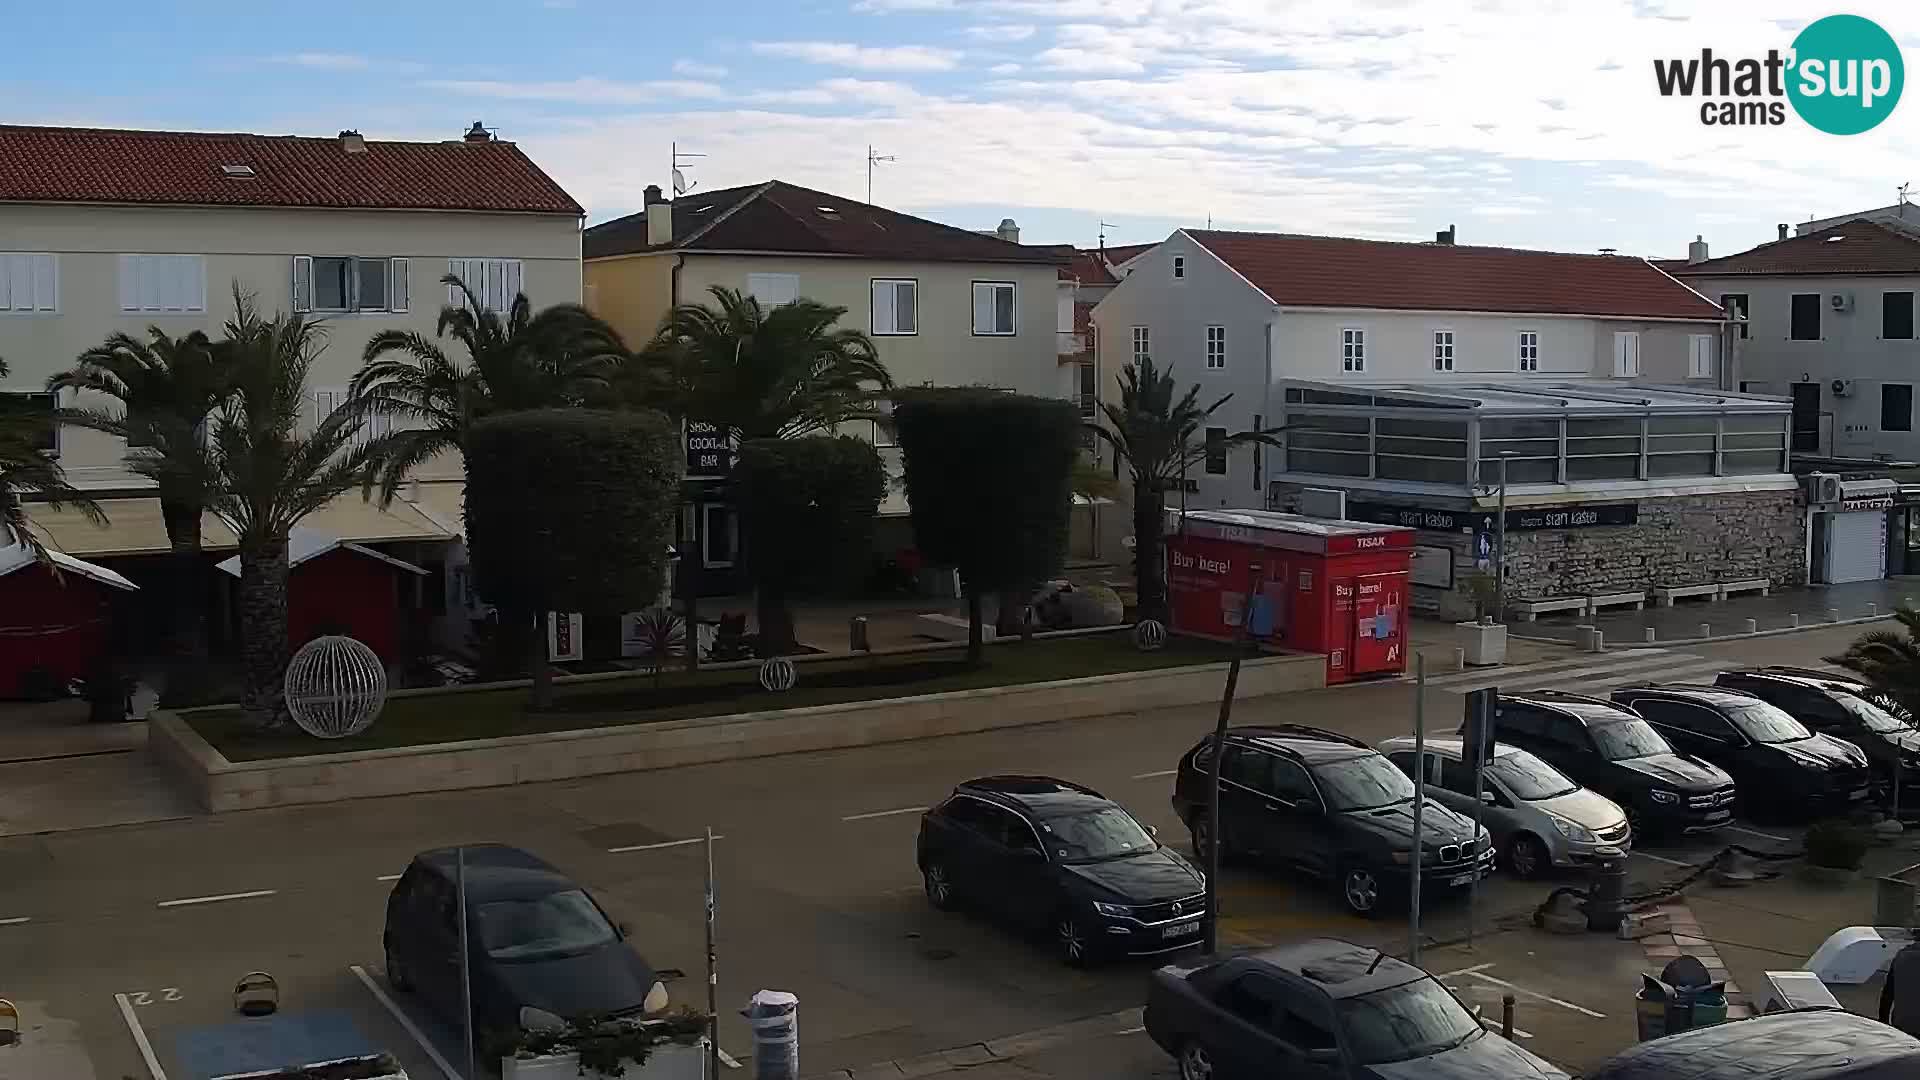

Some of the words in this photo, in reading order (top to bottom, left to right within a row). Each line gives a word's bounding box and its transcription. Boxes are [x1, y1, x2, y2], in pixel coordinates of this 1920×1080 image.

[700, 455, 718, 467] BAR
[1356, 536, 1385, 548] TISAK
[1173, 551, 1195, 569] Buy
[1336, 584, 1354, 597] Buy
[1359, 581, 1382, 594] here!
